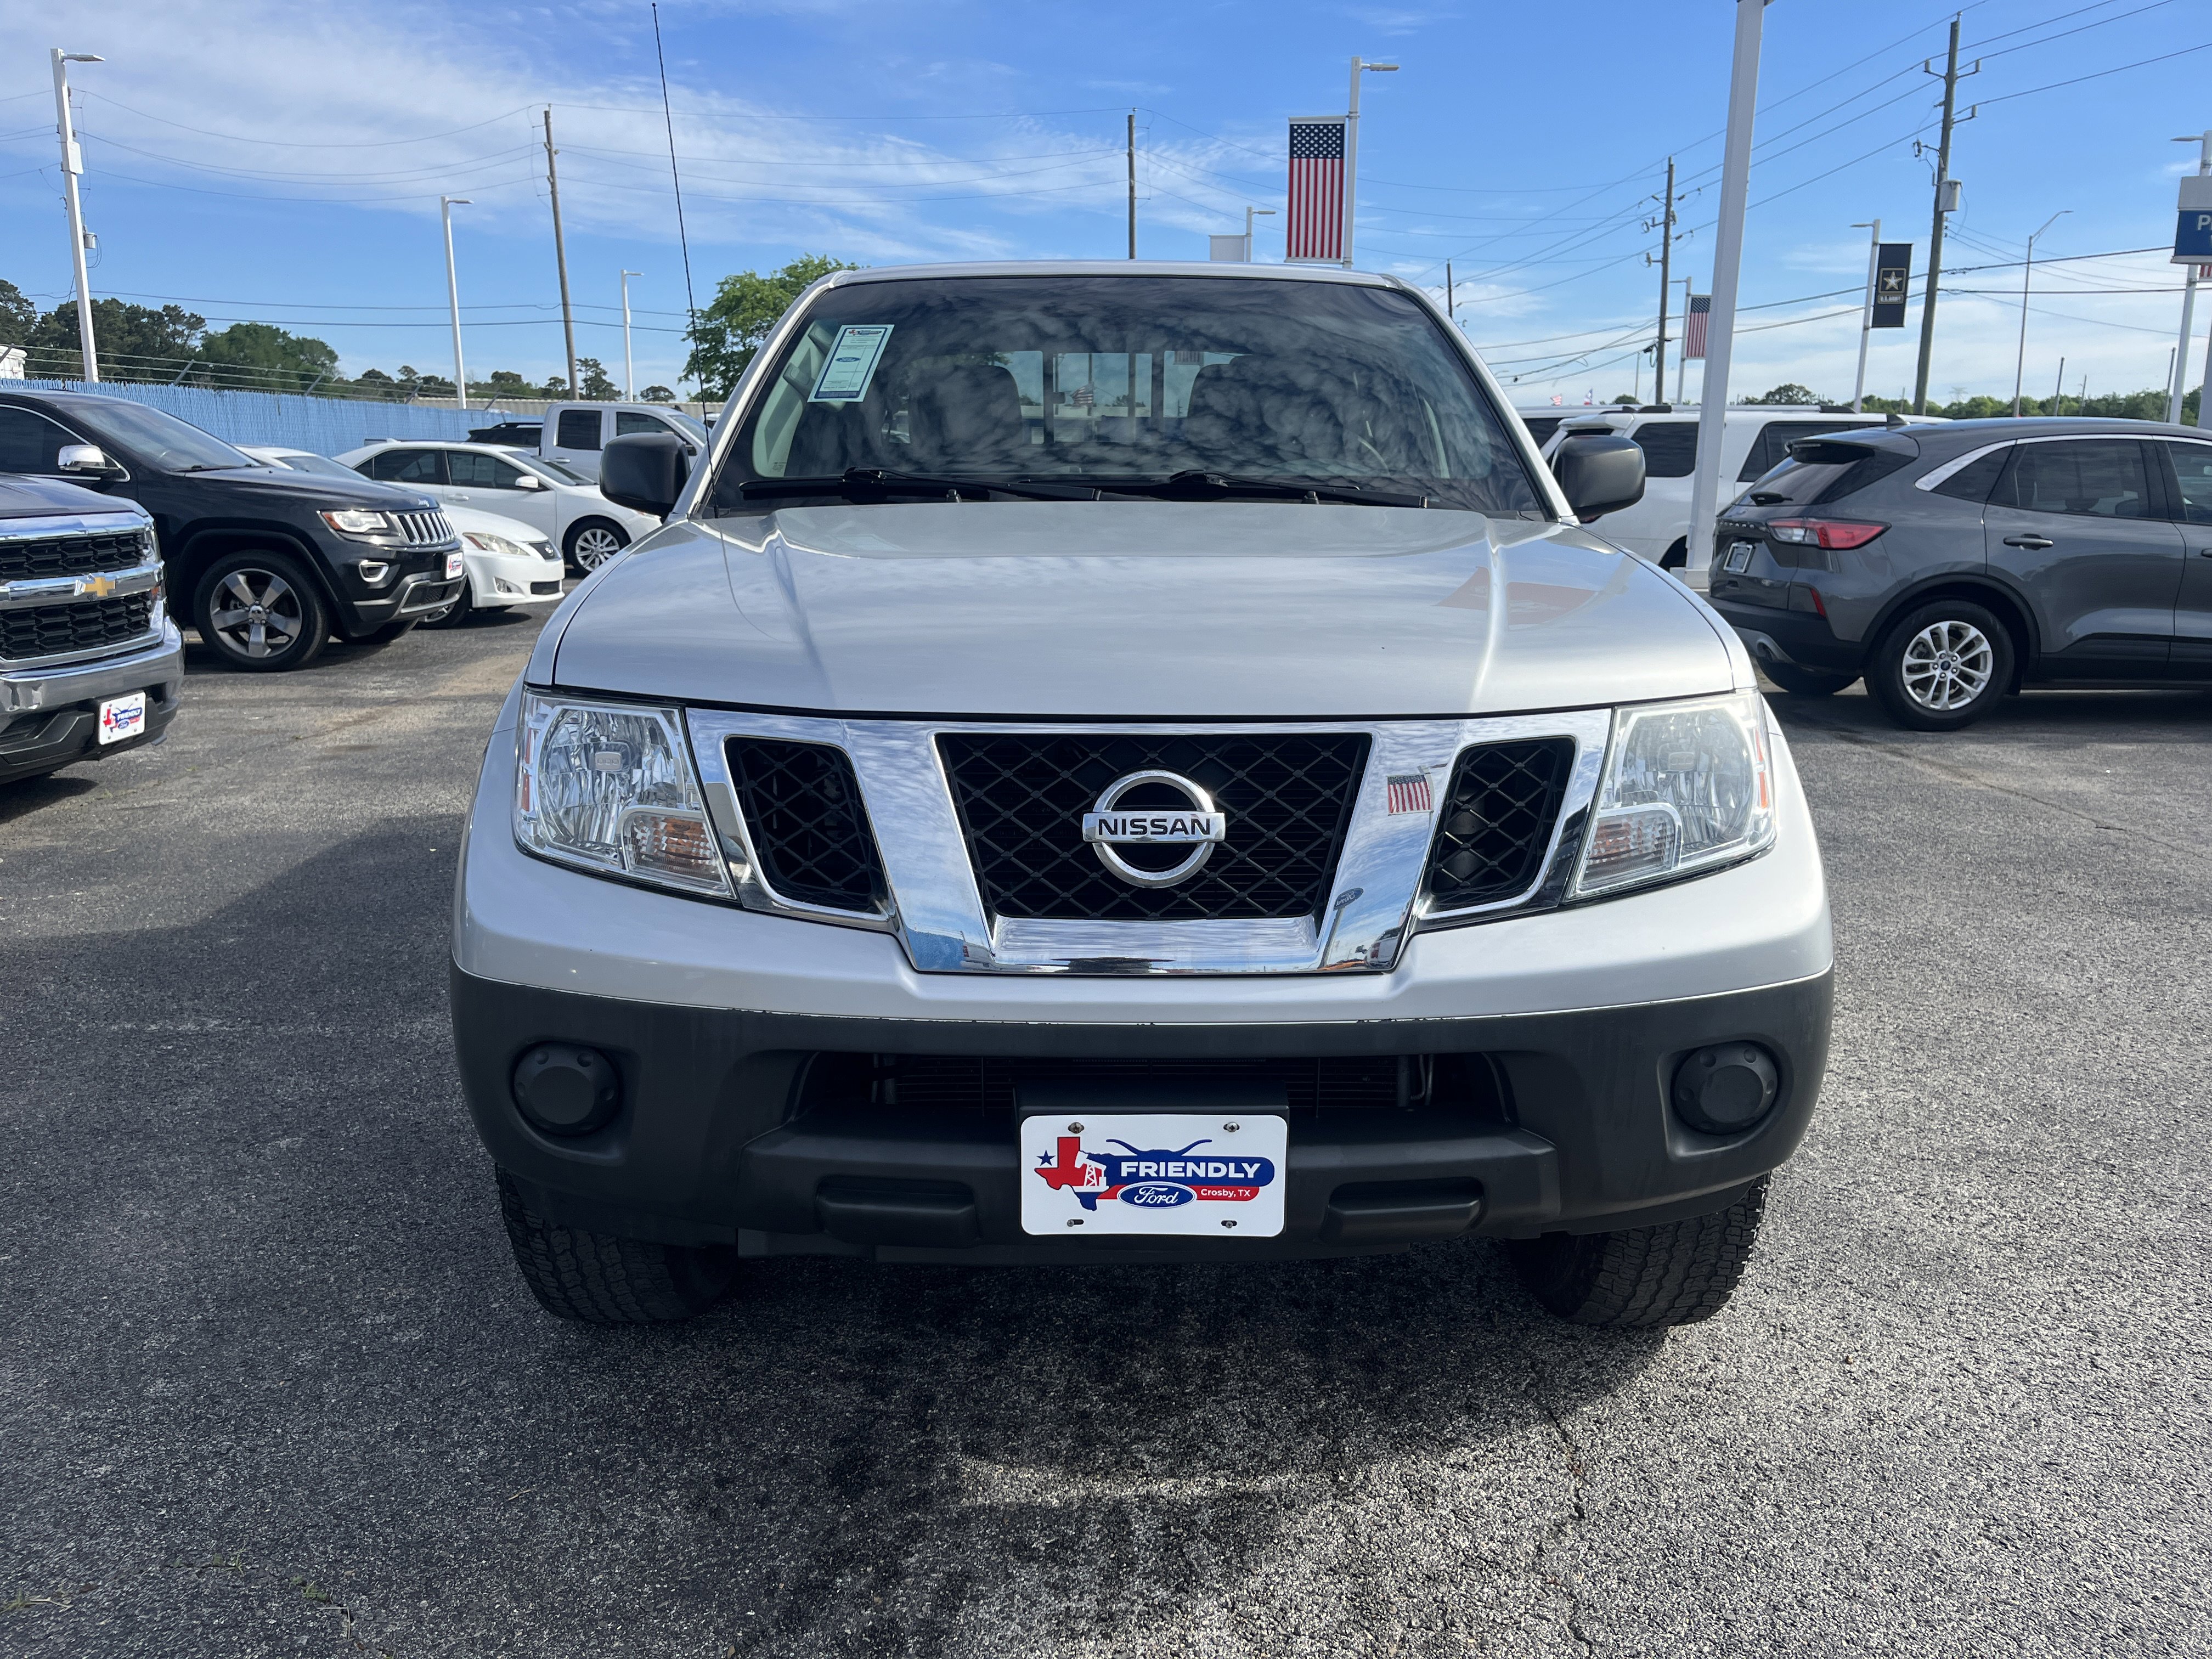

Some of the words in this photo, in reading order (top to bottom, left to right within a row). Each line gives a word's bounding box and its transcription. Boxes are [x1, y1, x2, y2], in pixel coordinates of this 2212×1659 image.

[1098, 818, 1210, 835] NISSAN
[1121, 1161, 1261, 1178] FRIENDLY
[1134, 1186, 1179, 1204] Ford
[1200, 1188, 1236, 1198] Crosby,
